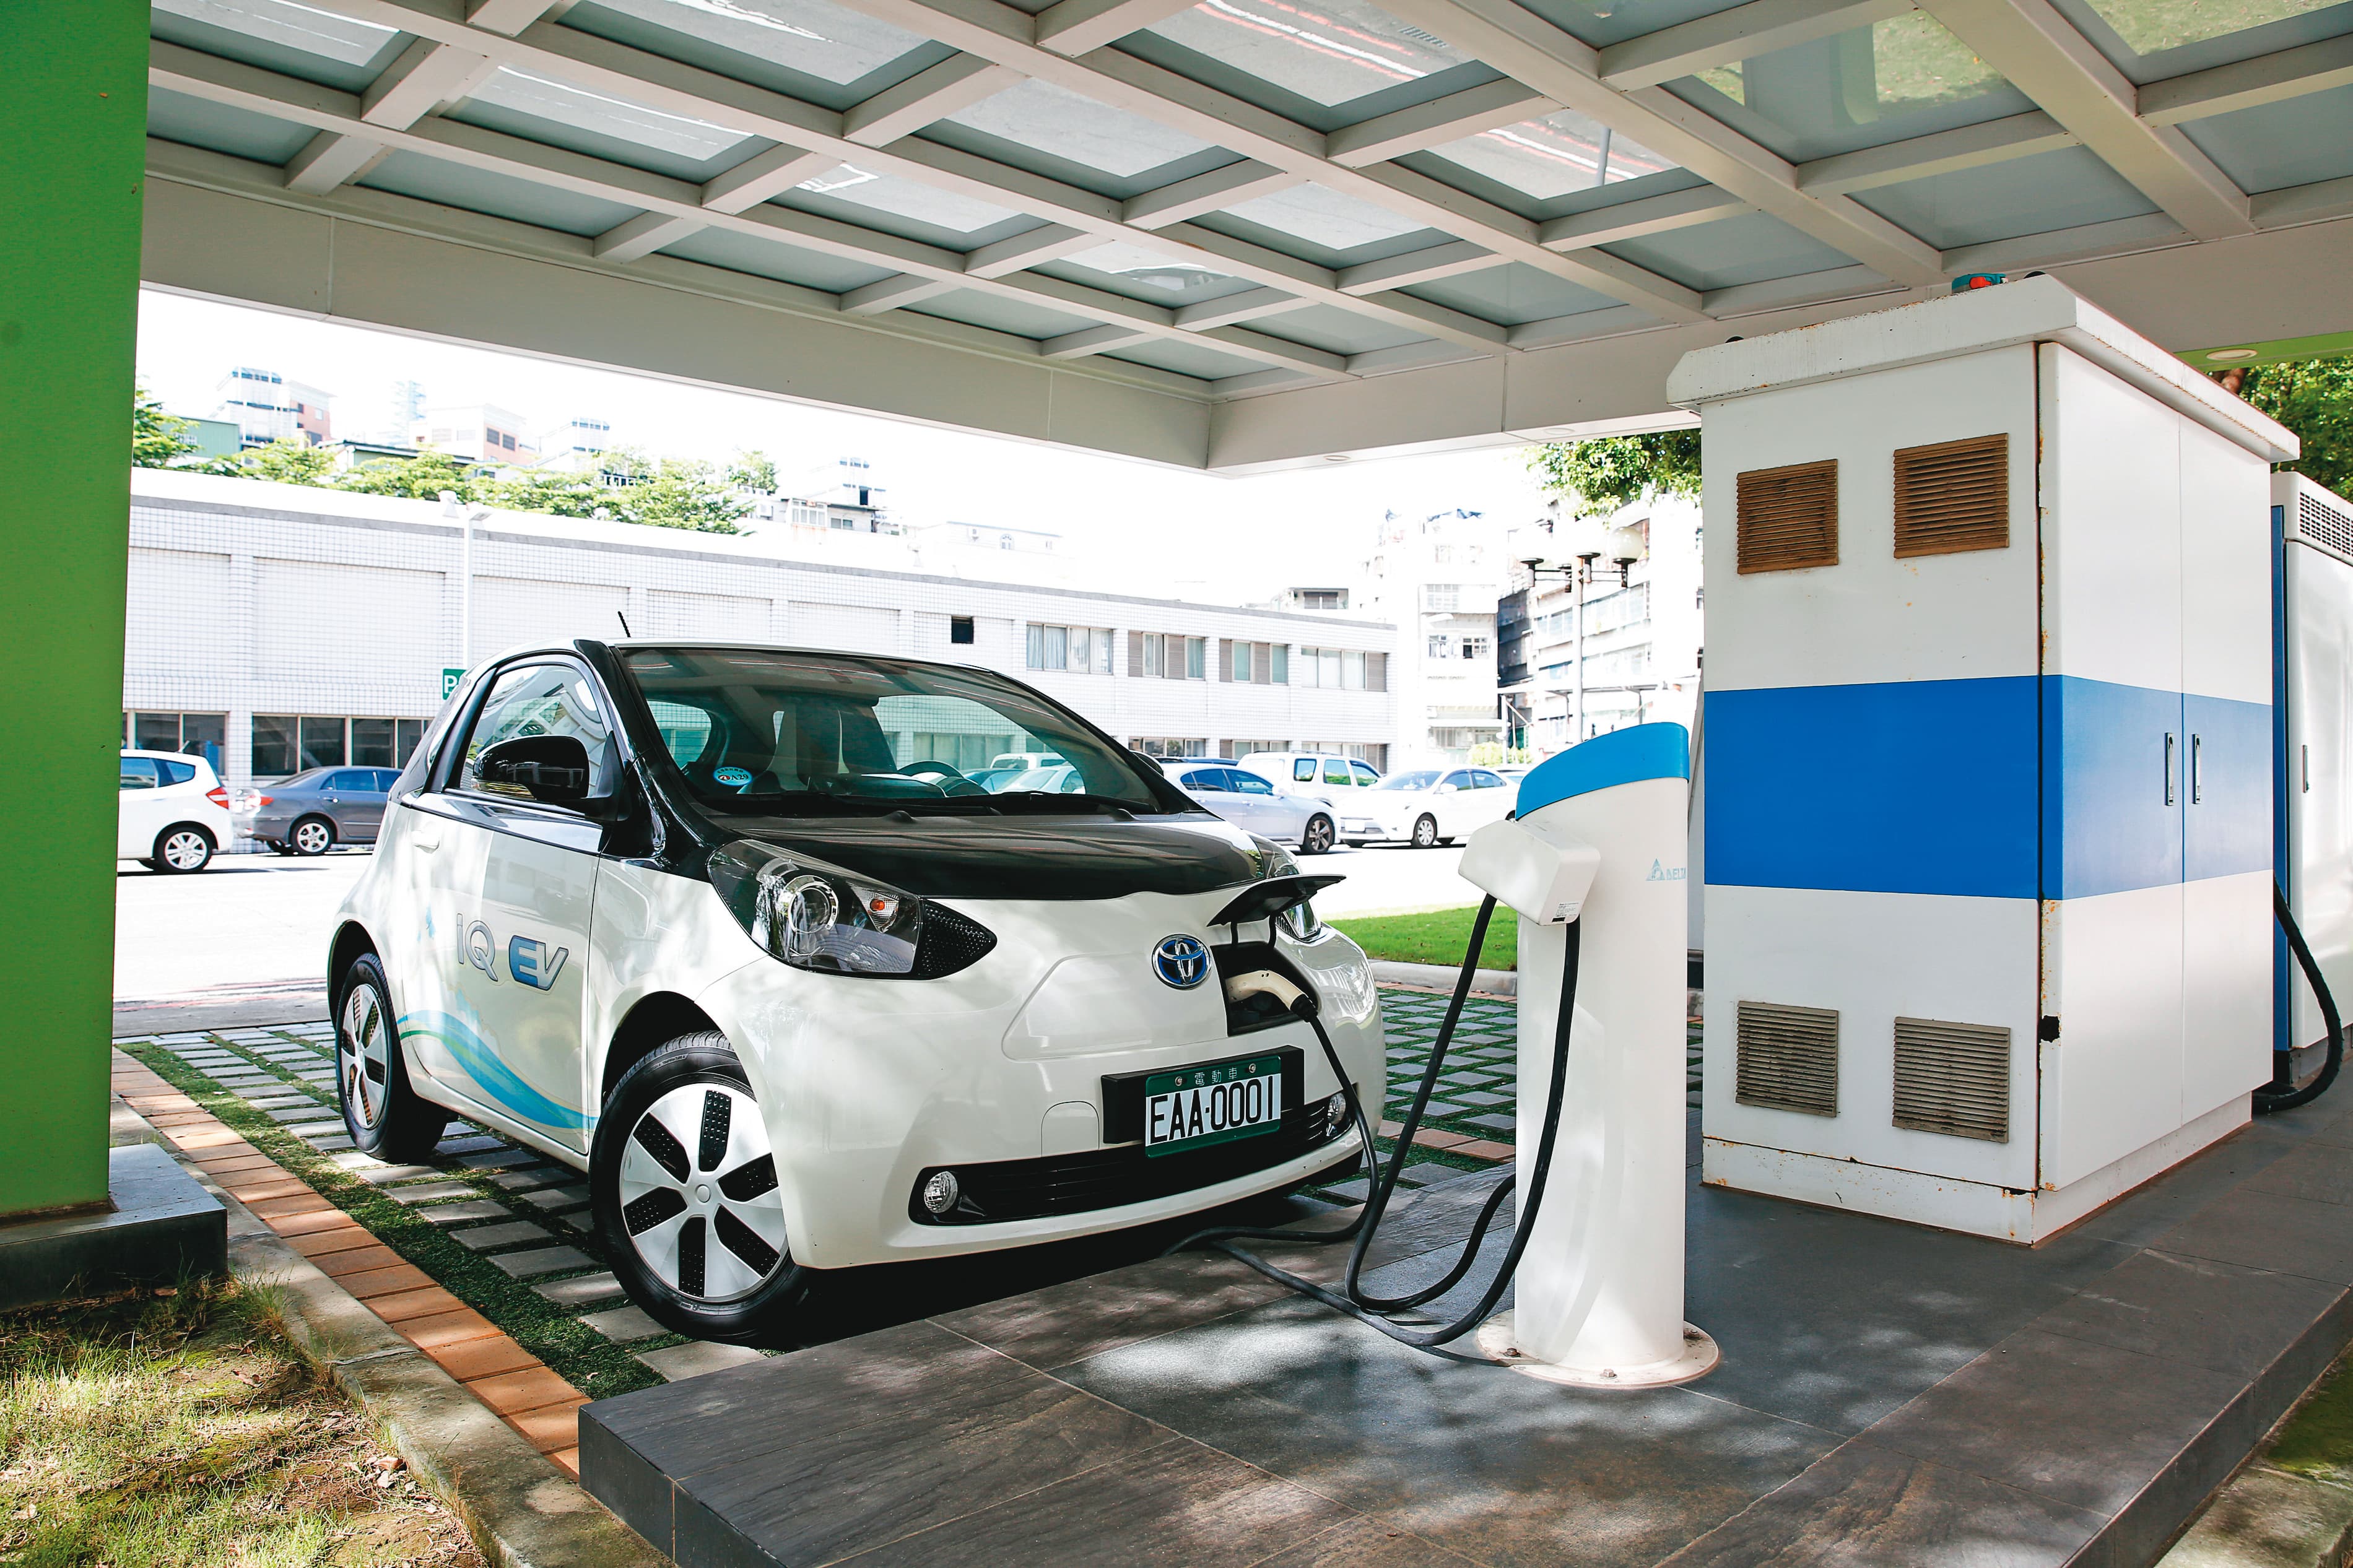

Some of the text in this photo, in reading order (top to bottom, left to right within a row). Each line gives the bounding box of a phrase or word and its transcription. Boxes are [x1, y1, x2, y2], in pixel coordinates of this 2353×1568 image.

[444, 675, 458, 693] P
[509, 935, 569, 991] EV
[1194, 1067, 1237, 1086] 電動車
